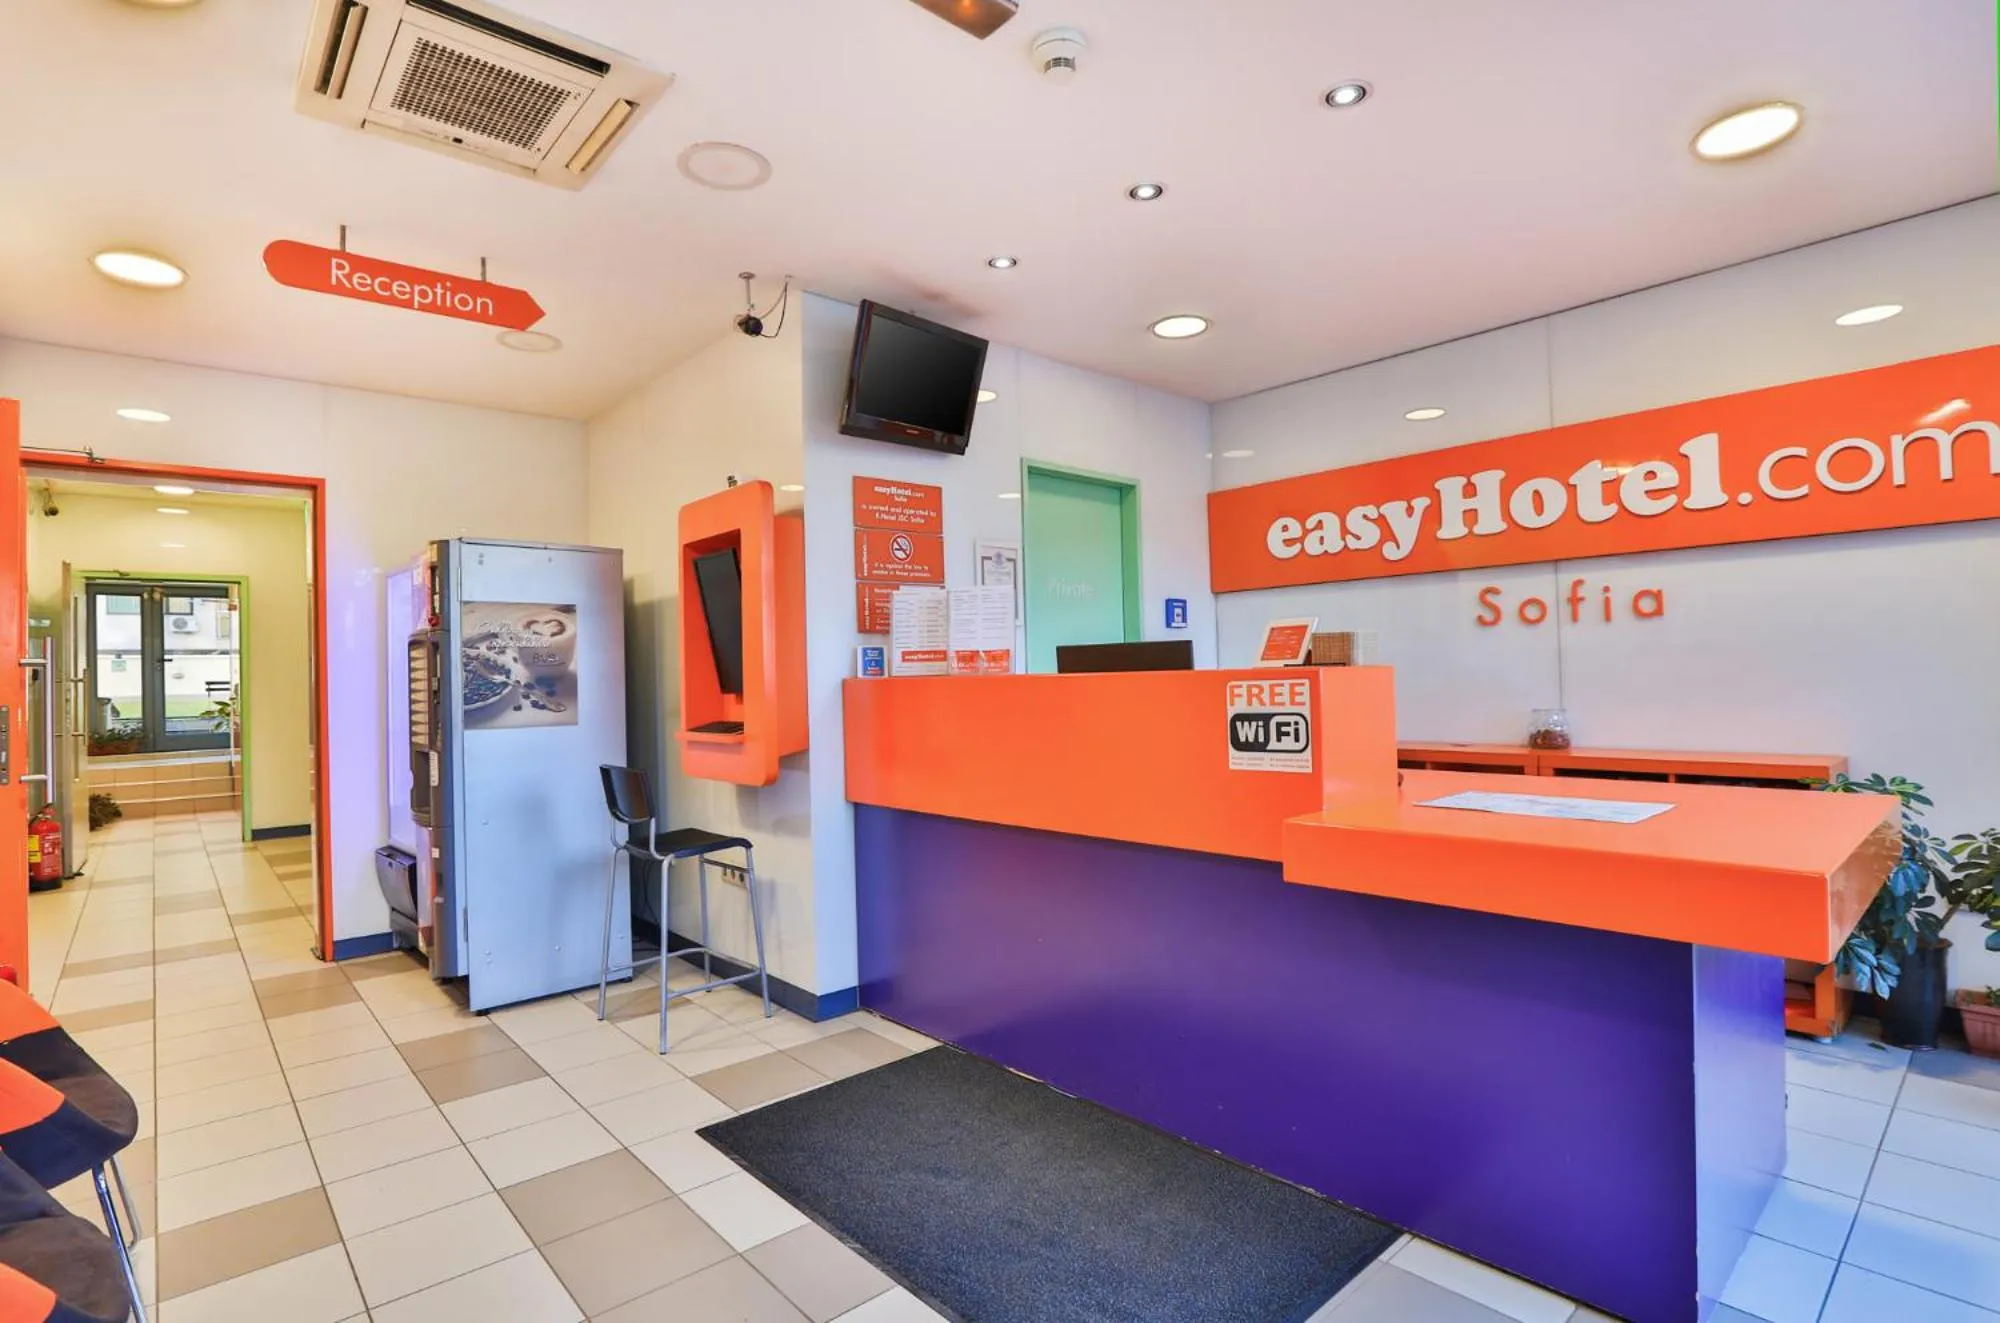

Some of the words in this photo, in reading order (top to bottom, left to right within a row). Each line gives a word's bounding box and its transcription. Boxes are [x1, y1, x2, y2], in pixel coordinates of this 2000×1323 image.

[330, 257, 494, 316] Reception
[1266, 420, 2000, 561] easyHotel.com
[1476, 577, 1665, 627] Sofia
[1229, 683, 1306, 706] FREE
